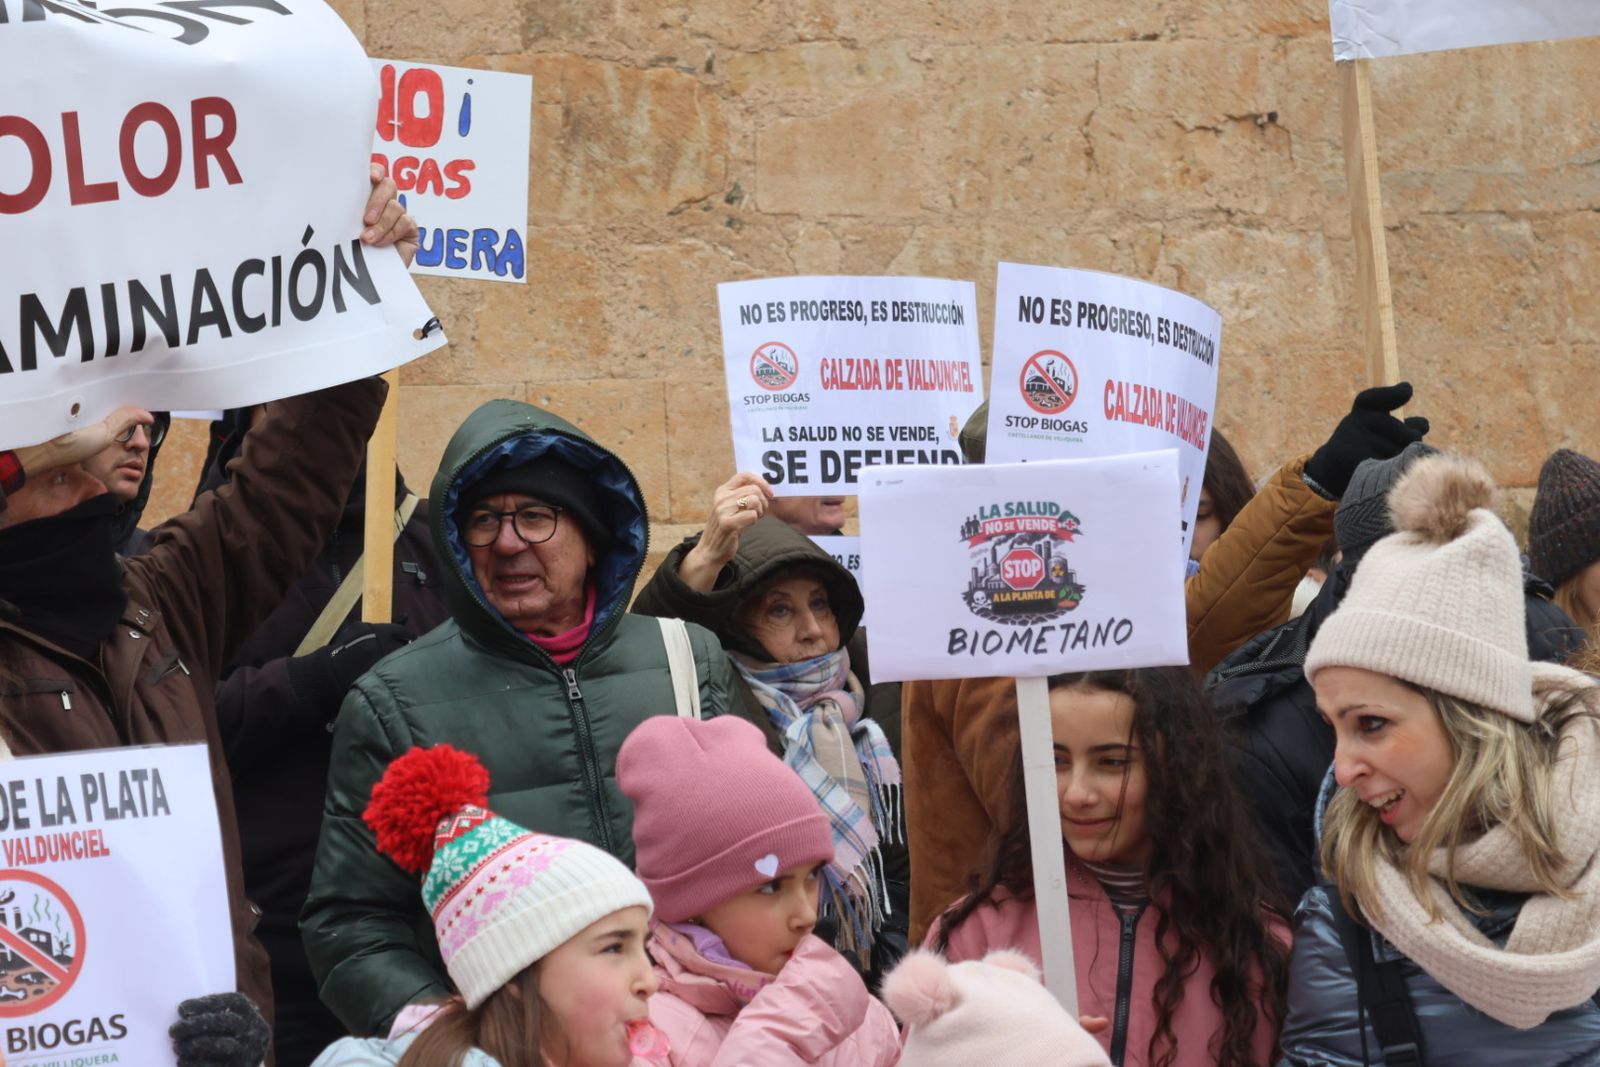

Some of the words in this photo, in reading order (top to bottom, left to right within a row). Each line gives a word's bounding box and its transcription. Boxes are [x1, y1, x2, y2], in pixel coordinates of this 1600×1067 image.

[0, 97, 243, 214] OLOR
[740, 304, 762, 325] NO
[766, 302, 786, 323] ES
[790, 300, 868, 326] PROGRESO,
[871, 301, 888, 322] ES
[892, 299, 964, 325] DESTRUCCIÓN
[1018, 295, 1045, 324] NO
[1050, 298, 1072, 327] ES
[1077, 302, 1154, 347] PROGRESO,
[1157, 317, 1171, 345] ES
[1173, 322, 1215, 367] DESTRUCCIÓN
[820, 358, 882, 390] CALZADA
[885, 359, 903, 390] DE
[905, 359, 974, 392] VALDUNCIEL
[743, 394, 771, 405] STOP
[773, 393, 811, 403] BIOGAS
[1104, 379, 1163, 430] CALZADA
[1165, 392, 1177, 434] DE
[762, 427, 784, 442] LA
[789, 426, 837, 441] SALUD
[842, 426, 862, 441] NO
[867, 426, 884, 441] SE
[889, 426, 939, 444] VENDE,
[1005, 415, 1039, 429] STOP
[1041, 418, 1088, 433] BIOGAS
[761, 450, 808, 485] SE
[979, 504, 1001, 520] LA
[1004, 501, 1060, 517] SALUD
[985, 521, 1003, 535] NO
[1004, 521, 1015, 531] SE
[1016, 518, 1056, 533] VENDE
[847, 554, 860, 570] ES
[1003, 559, 1041, 579] STOP
[993, 594, 1000, 602] A
[1001, 593, 1011, 602] LA
[1012, 590, 1044, 602] PLANTA
[1045, 590, 1055, 599] DE
[947, 617, 1133, 656] BIOMETANO
[36, 776, 77, 827] LA
[80, 768, 171, 822] PLATA
[2, 829, 110, 867] VALDUNCIEL
[7, 1014, 128, 1054] BIOGAS
